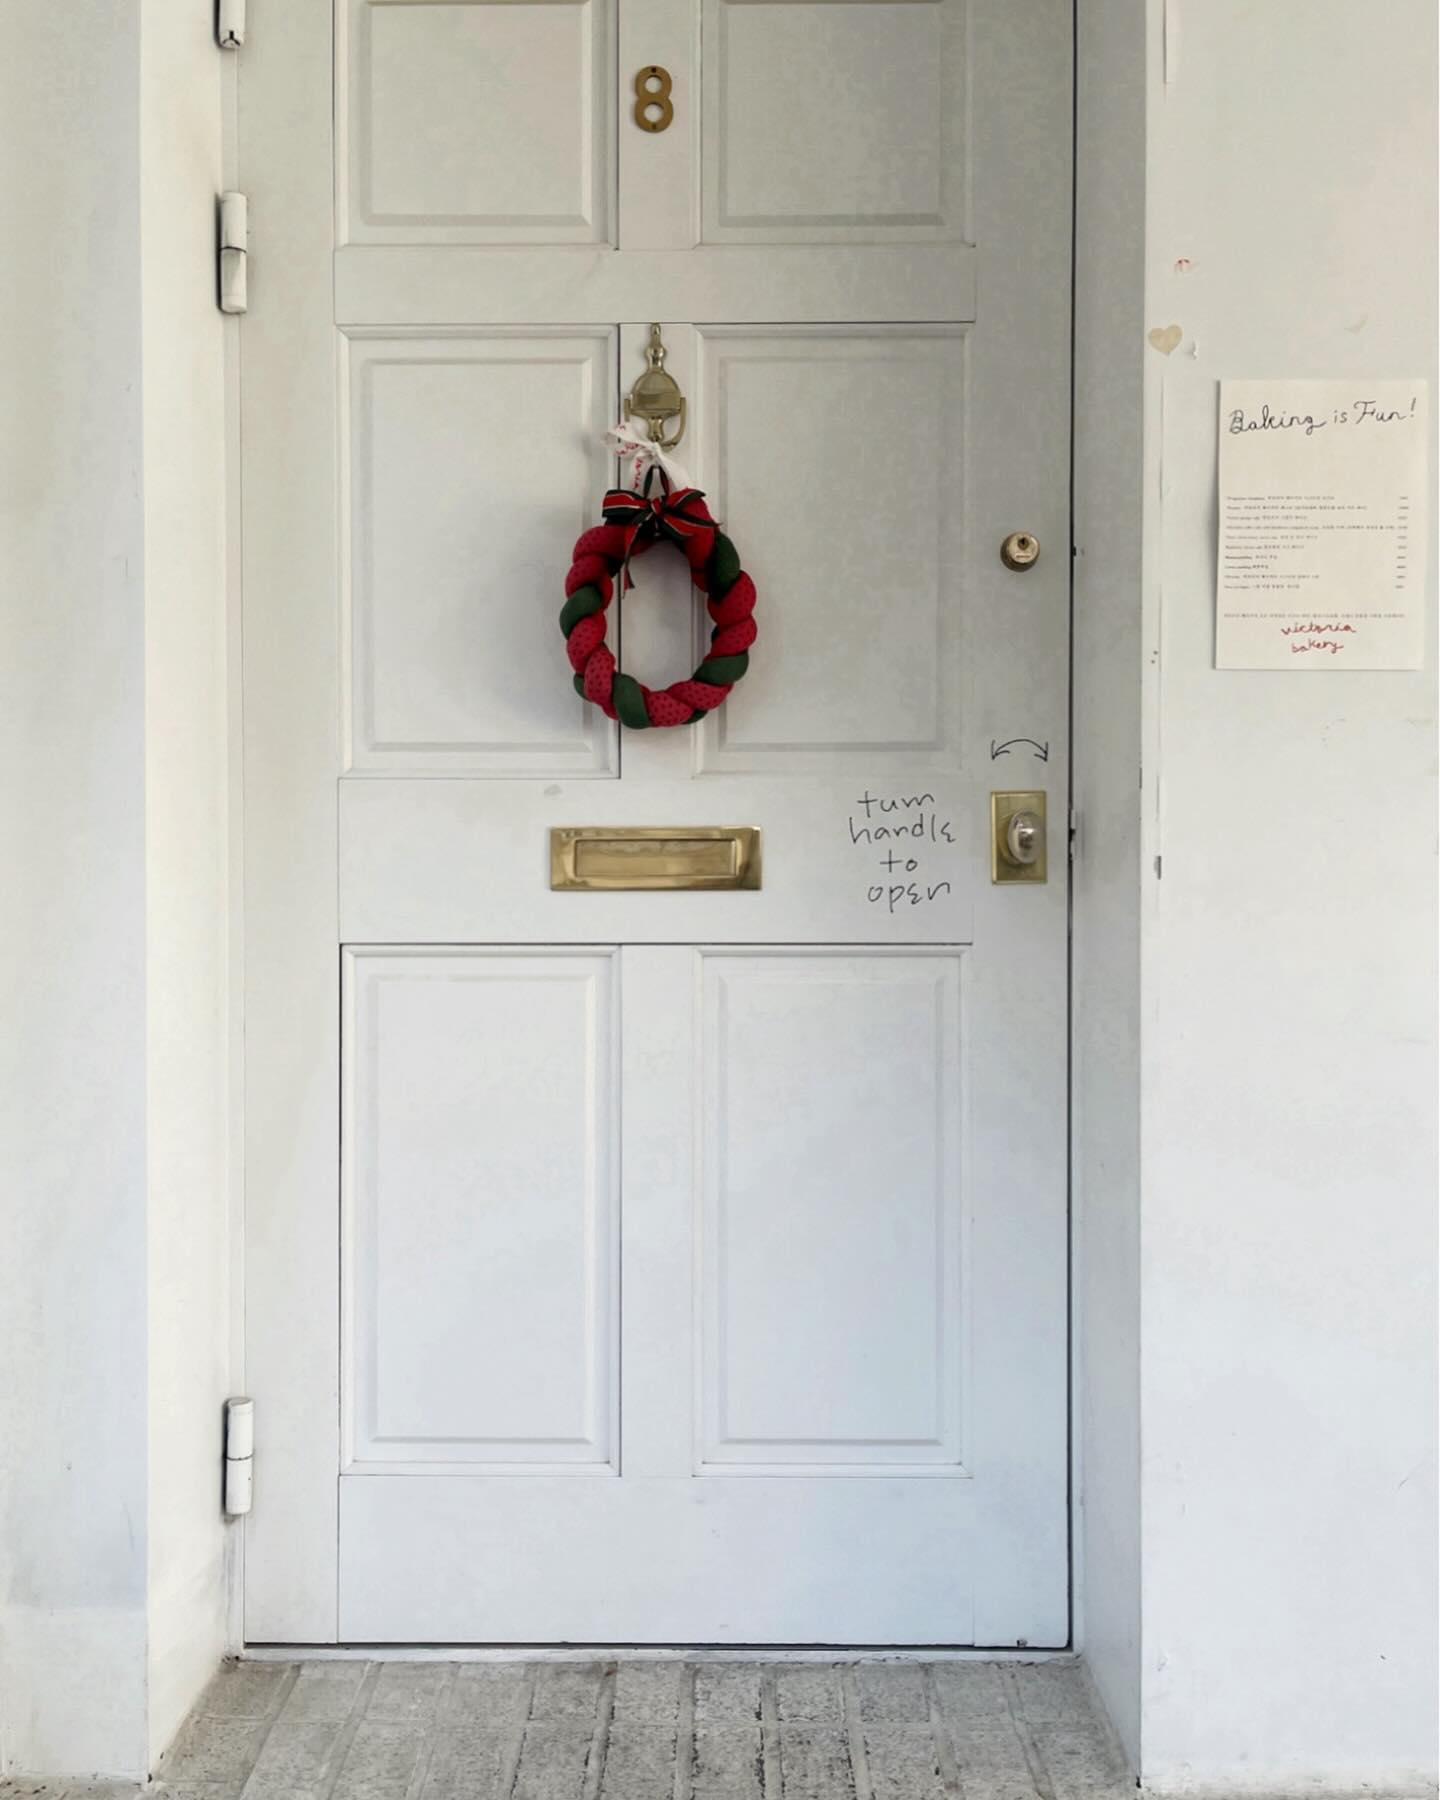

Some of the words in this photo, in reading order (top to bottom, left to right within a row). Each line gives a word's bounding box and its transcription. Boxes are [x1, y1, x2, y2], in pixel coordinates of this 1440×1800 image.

[634, 65, 674, 134] 8
[1229, 404, 1327, 436] Baking
[1333, 409, 1348, 424] is
[1353, 397, 1417, 425] Fun!
[1281, 621, 1357, 635] victoria
[1291, 638, 1344, 654] bakery
[857, 790, 935, 818] turn
[849, 813, 957, 844] handle
[879, 848, 919, 873] to
[867, 882, 951, 913] open
